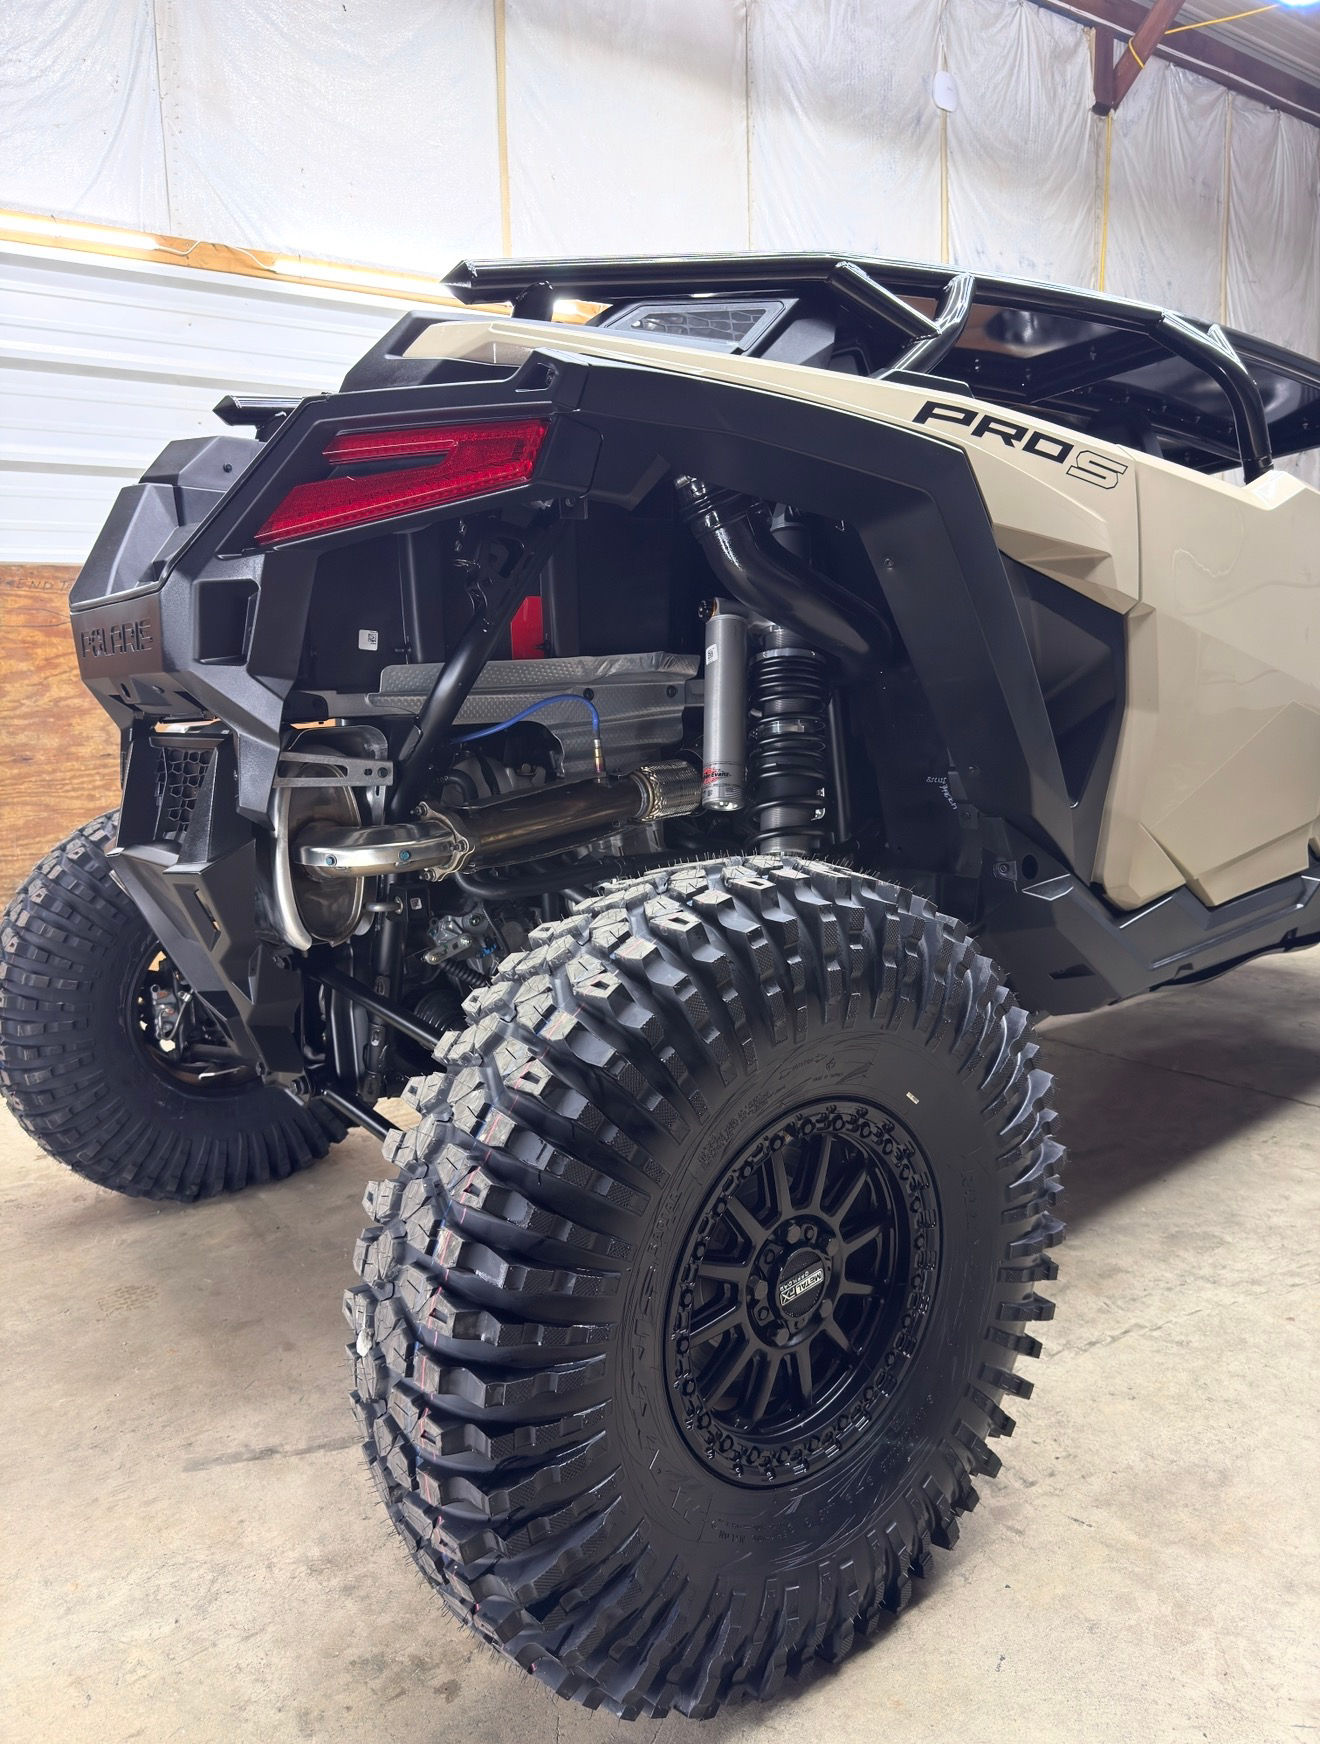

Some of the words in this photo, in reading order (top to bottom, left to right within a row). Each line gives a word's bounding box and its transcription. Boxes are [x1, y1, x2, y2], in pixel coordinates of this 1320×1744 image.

[912, 400, 1075, 464] PRO
[1066, 450, 1128, 489] S
[81, 619, 153, 658] POLARIS
